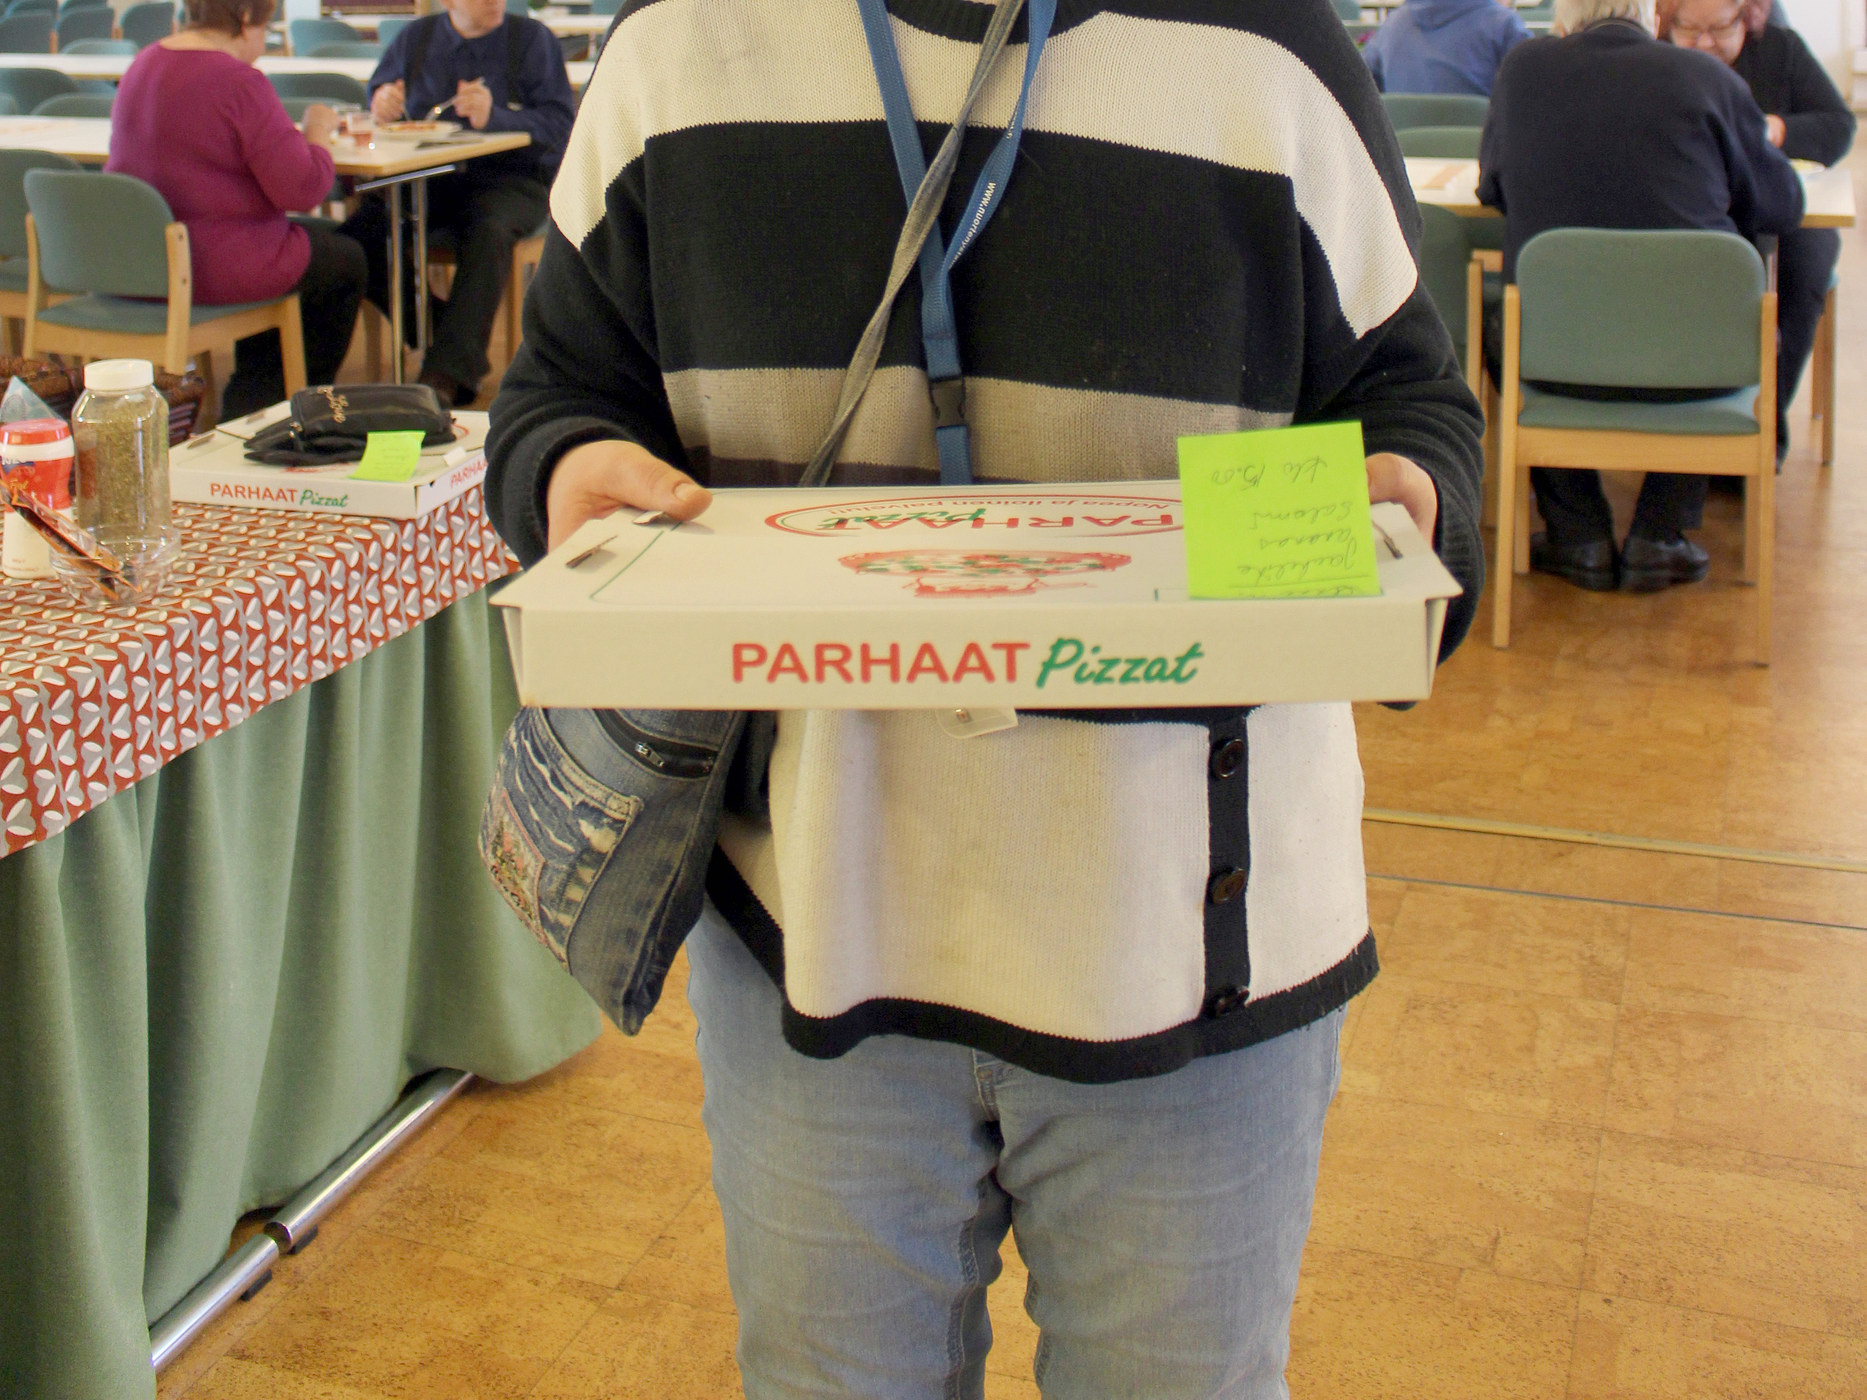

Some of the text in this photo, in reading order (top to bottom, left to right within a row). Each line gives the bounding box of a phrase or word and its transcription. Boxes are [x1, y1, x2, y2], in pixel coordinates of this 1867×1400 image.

[210, 482, 350, 509] PARHAAT Pizzat
[952, 499, 1042, 507] iloinen
[1051, 500, 1078, 508] ja
[1082, 501, 1169, 510] Nopea
[817, 513, 1175, 531] PARHAAT
[731, 636, 1206, 690] PARHAAT Pizzat
